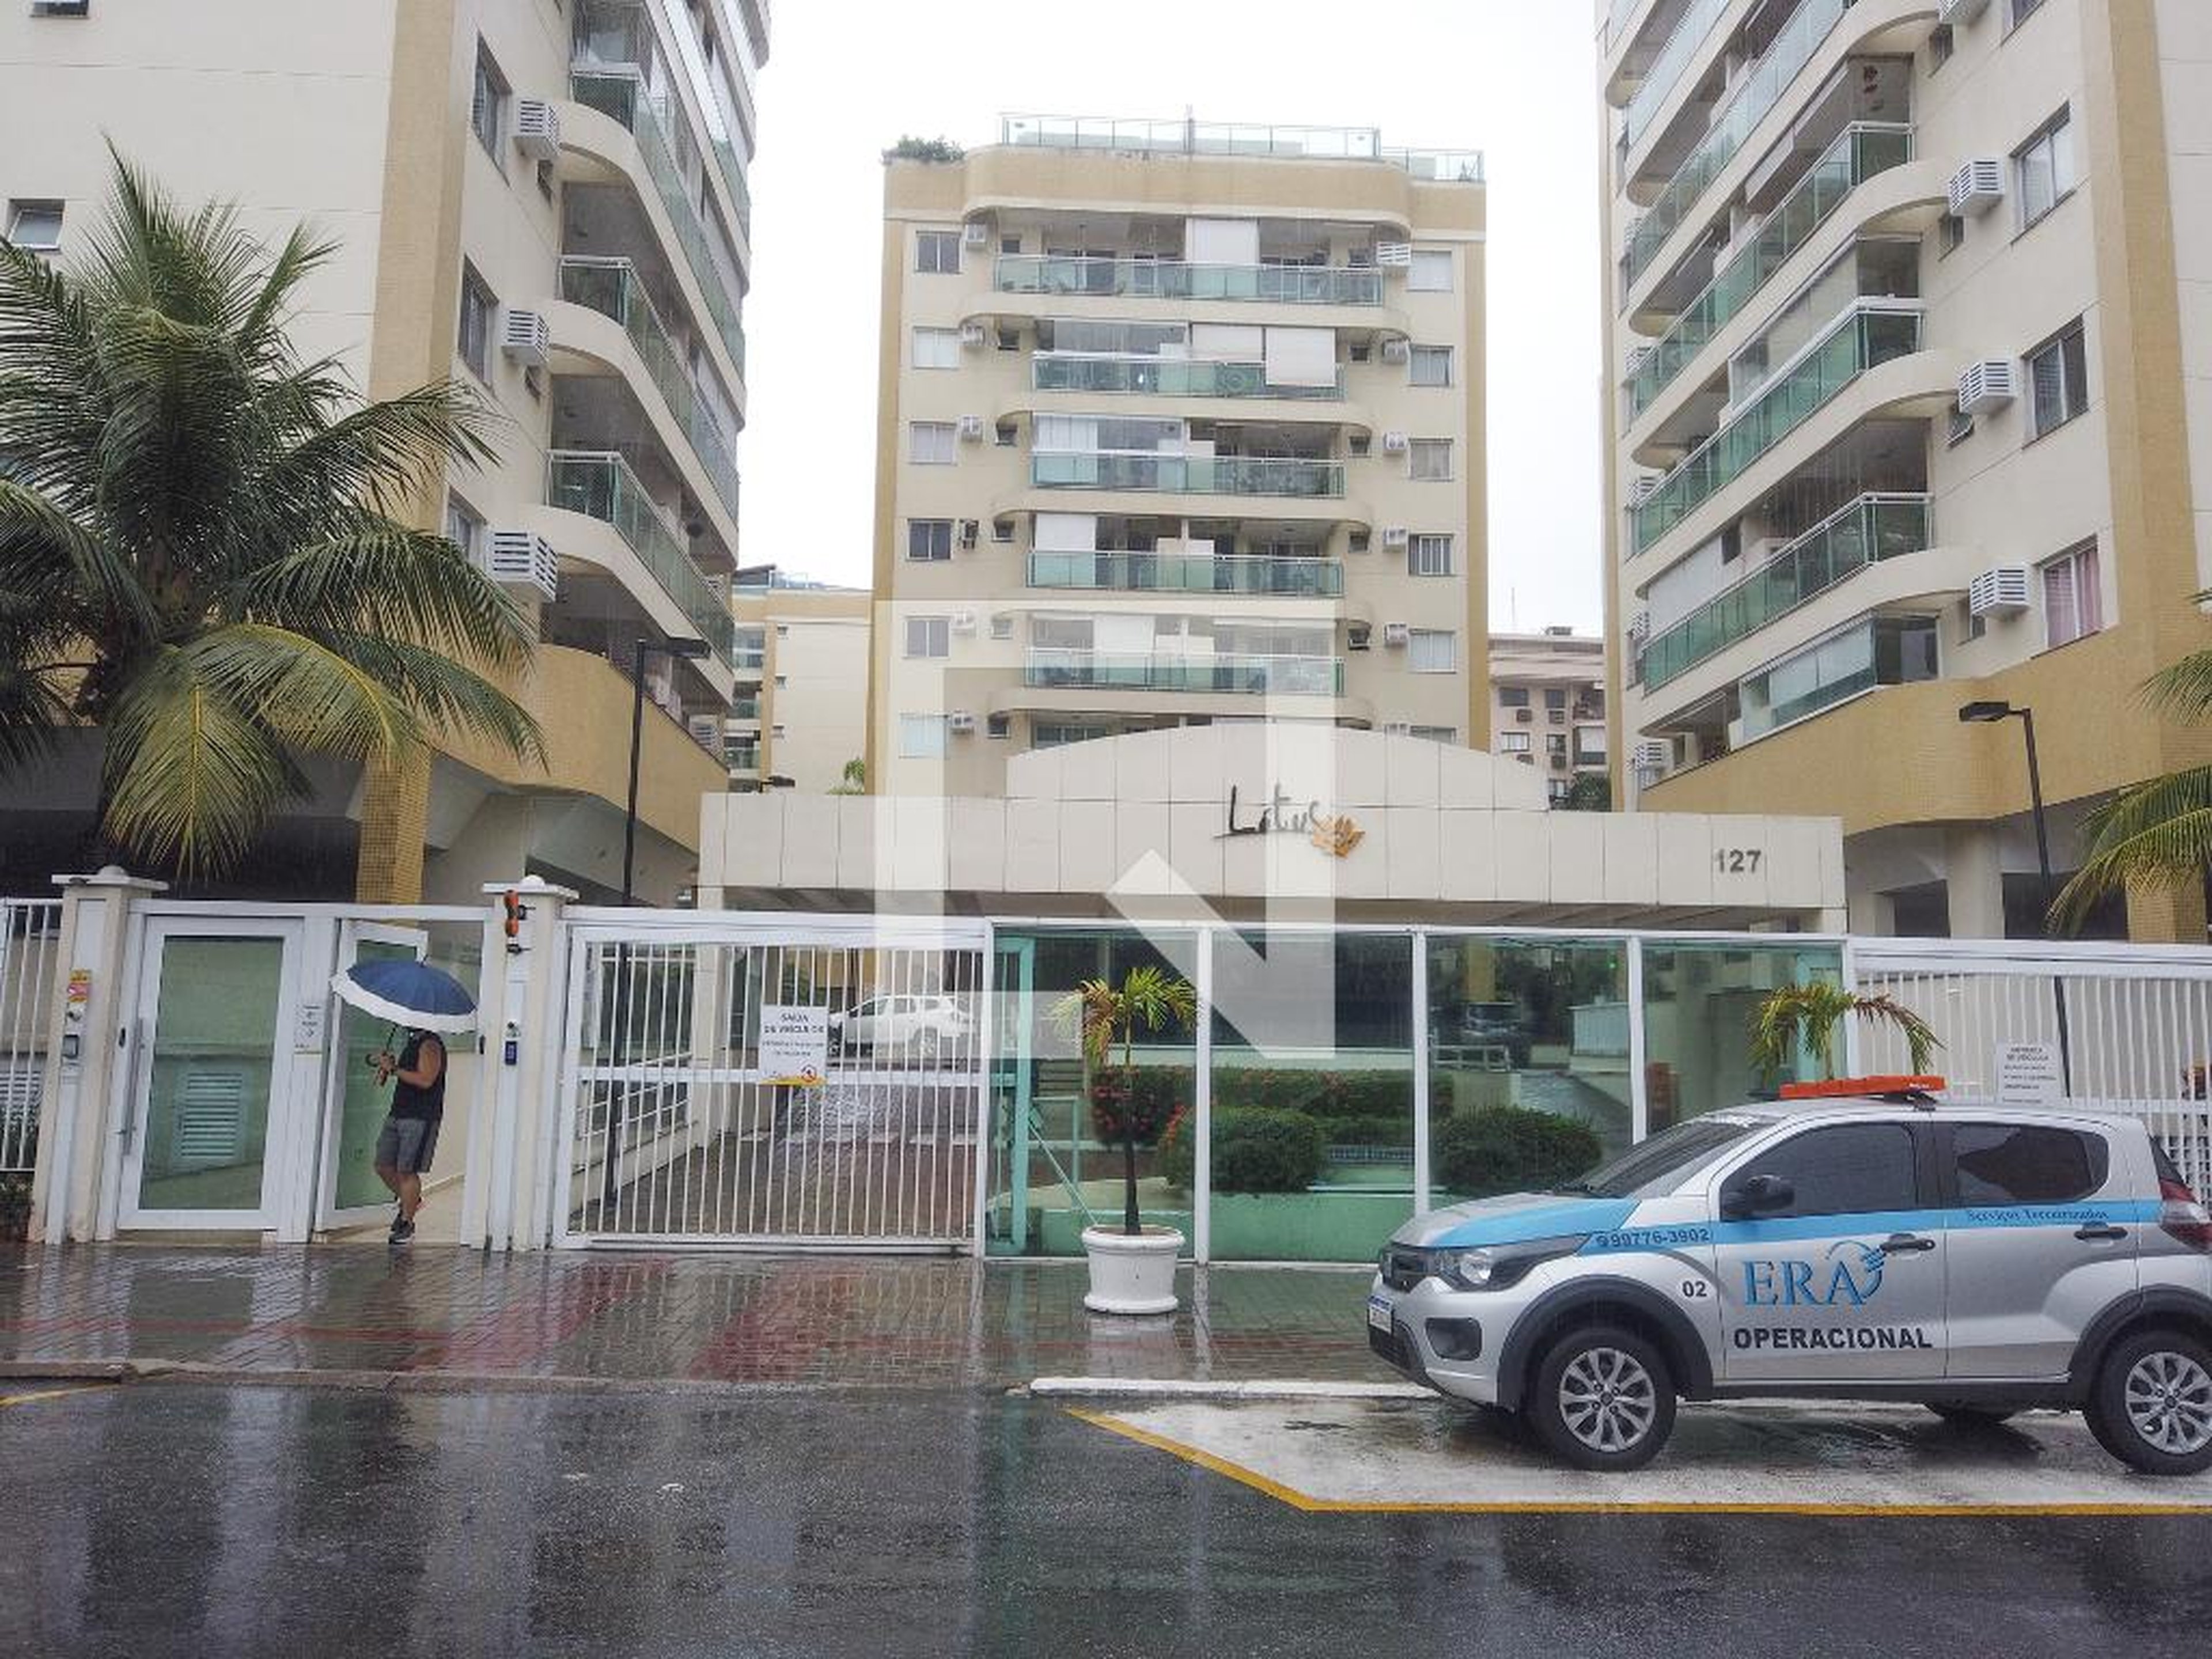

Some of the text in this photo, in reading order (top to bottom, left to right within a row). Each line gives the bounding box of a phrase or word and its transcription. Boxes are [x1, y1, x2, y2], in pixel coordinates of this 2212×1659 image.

[1717, 848, 1762, 874] 127
[1682, 1281, 1707, 1297] 02
[1742, 1260, 1867, 1305] ERA
[1733, 1327, 1933, 1349] OPERACIONAL
